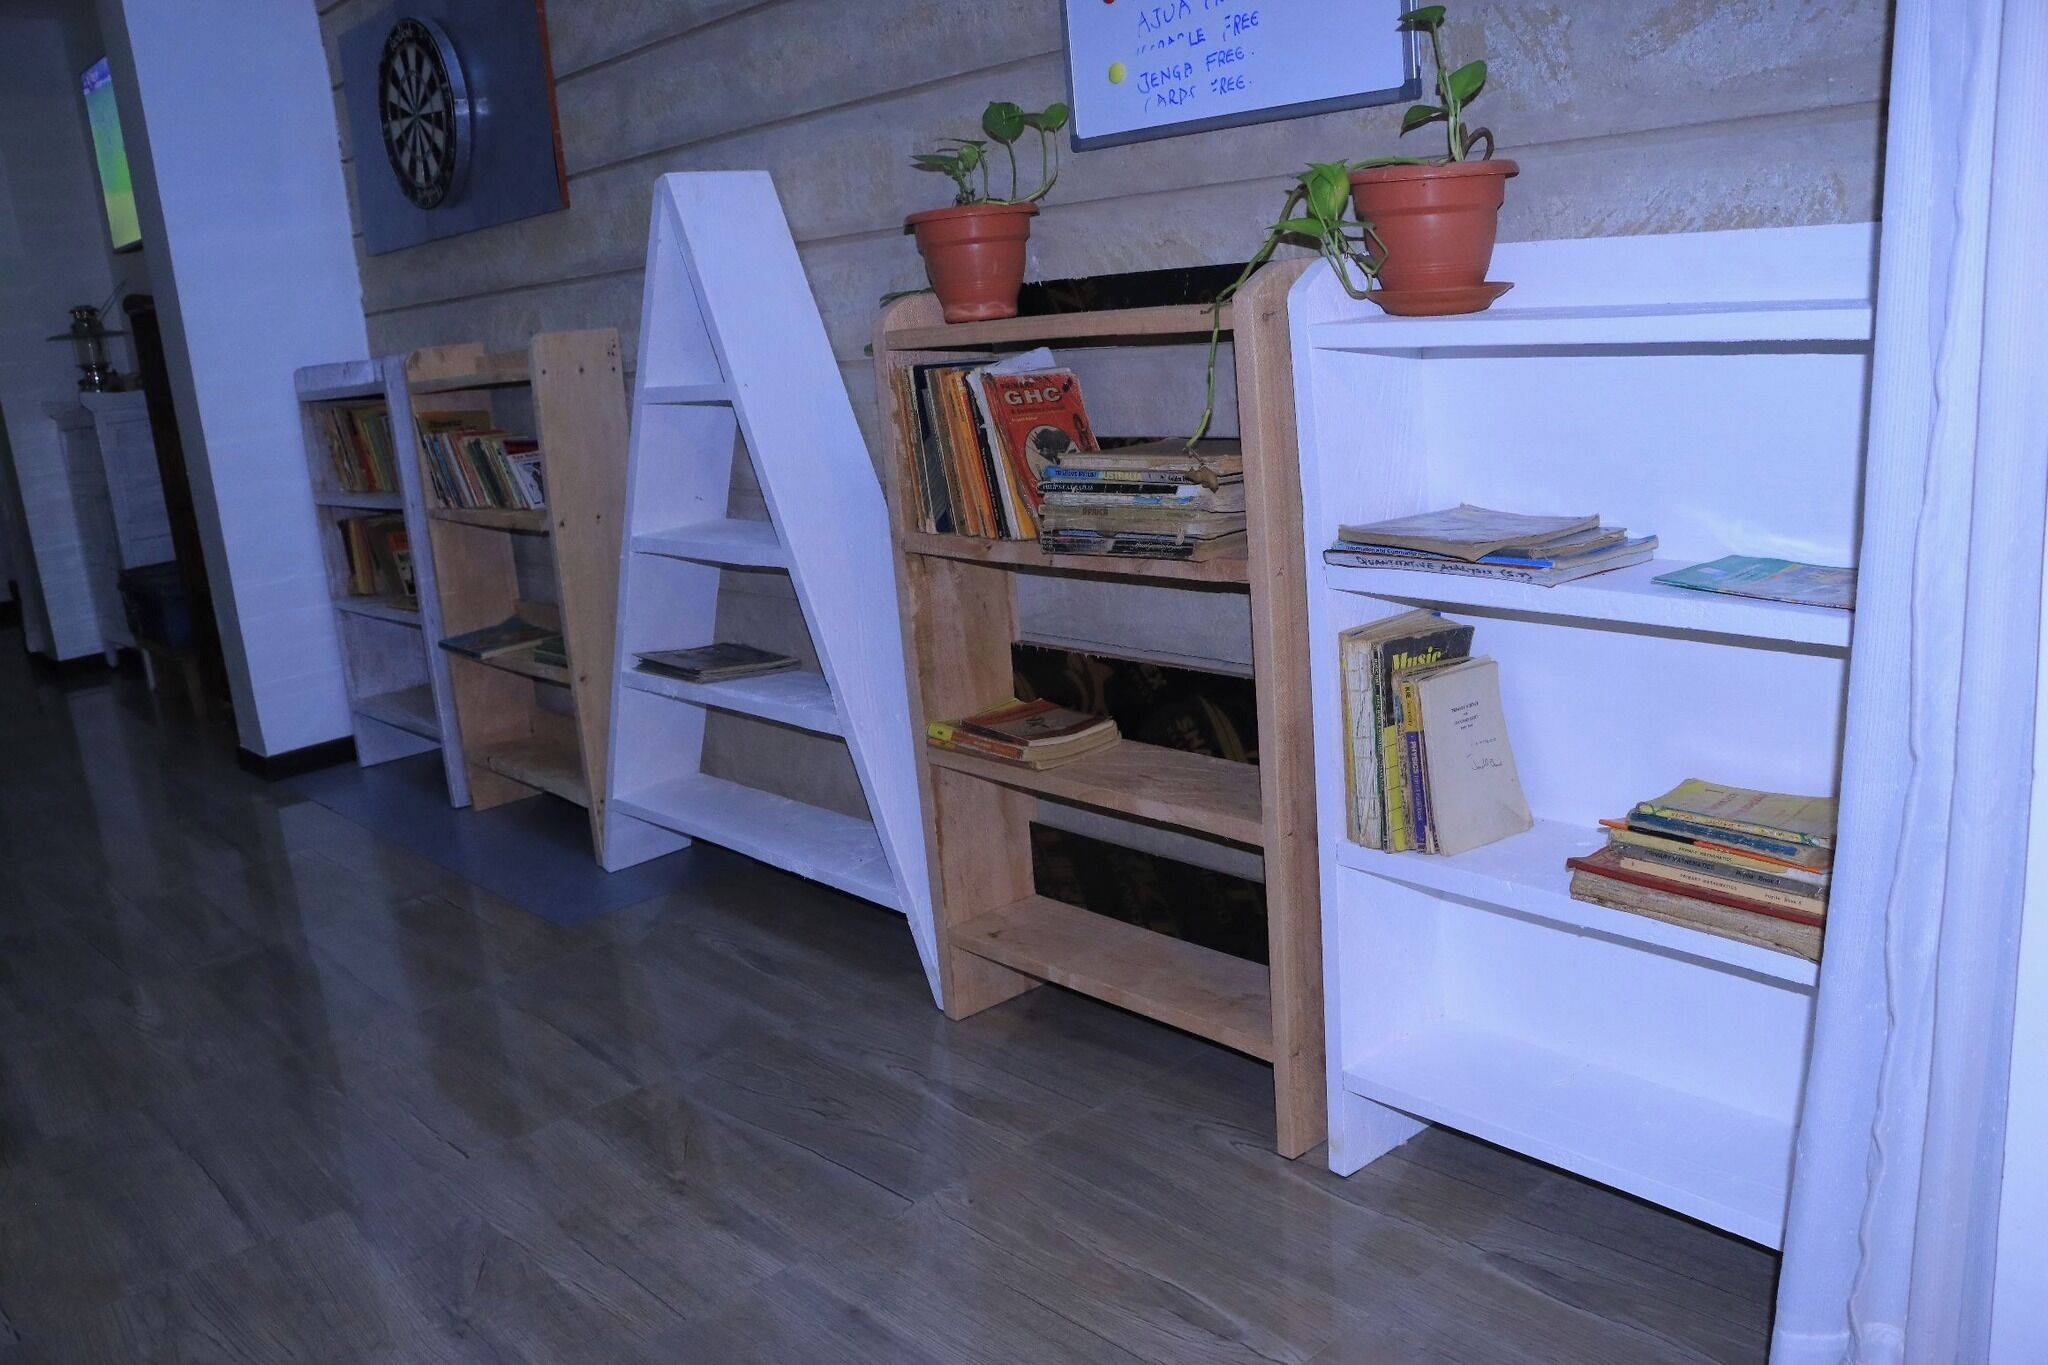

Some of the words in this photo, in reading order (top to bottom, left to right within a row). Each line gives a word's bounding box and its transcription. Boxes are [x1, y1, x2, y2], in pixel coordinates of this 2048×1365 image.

[1137, 62, 1193, 95] JENGA
[1004, 386, 1062, 406] GHC
[1410, 741, 1420, 774] PHYSICS
